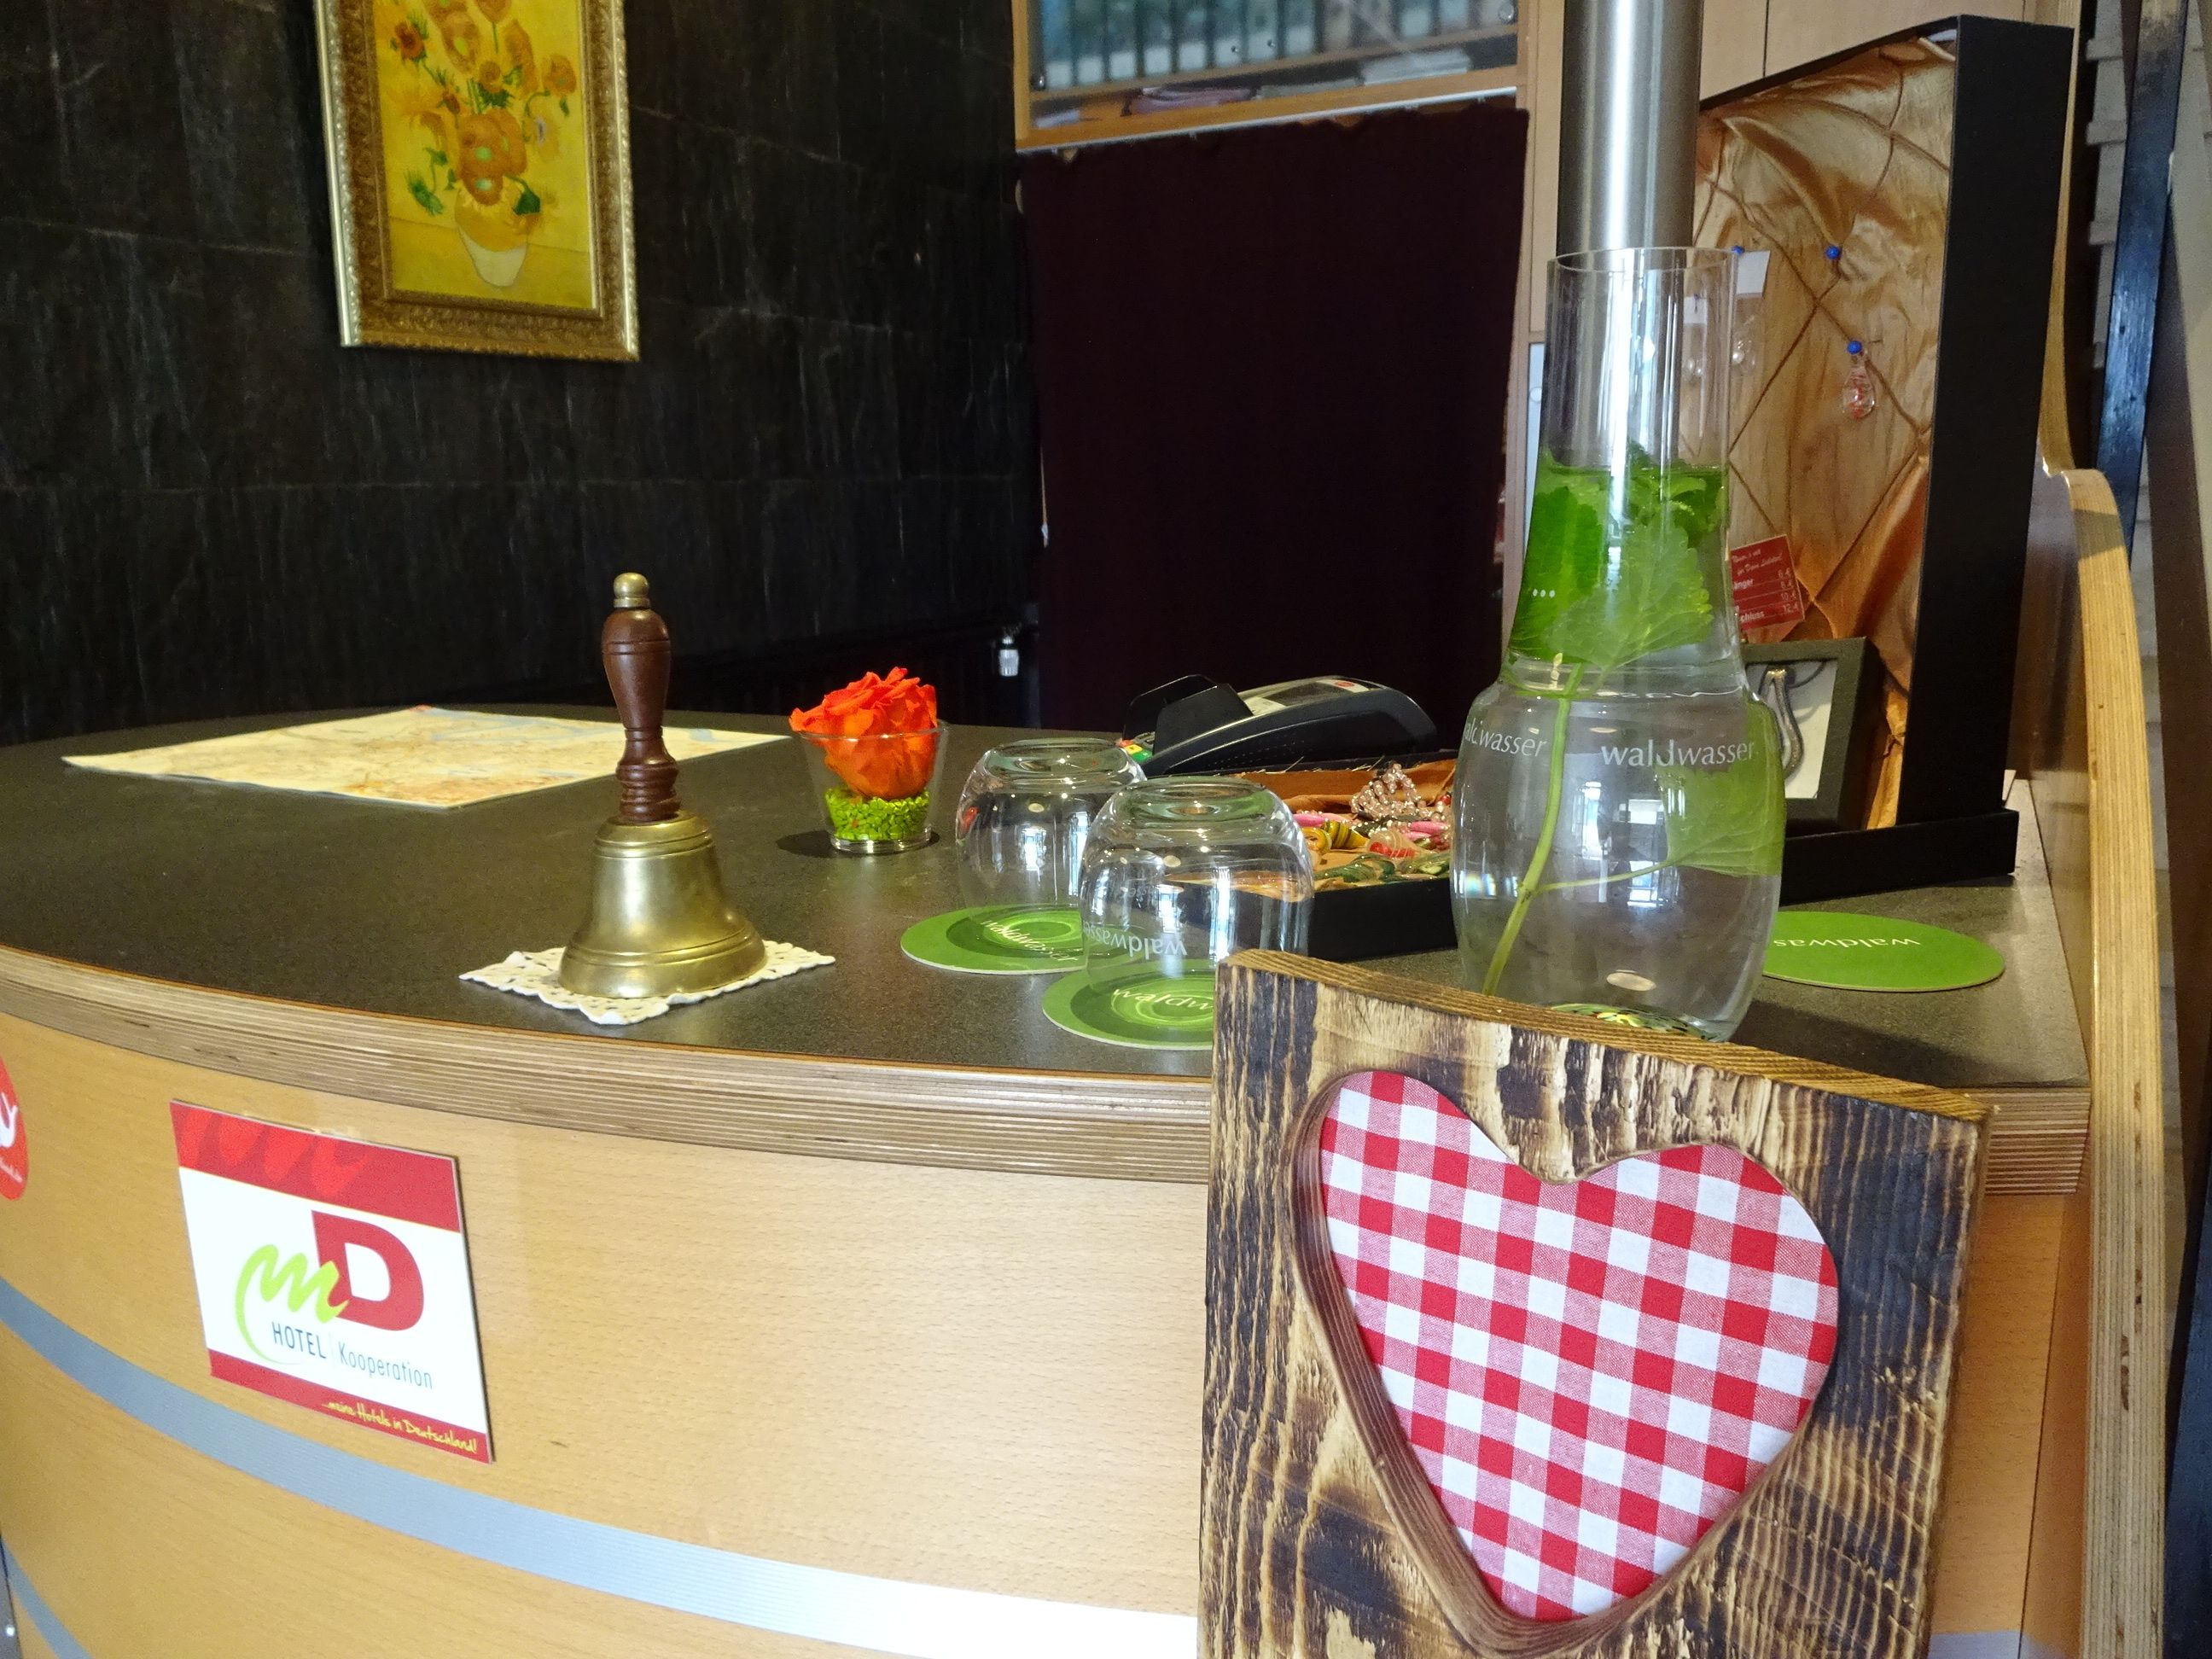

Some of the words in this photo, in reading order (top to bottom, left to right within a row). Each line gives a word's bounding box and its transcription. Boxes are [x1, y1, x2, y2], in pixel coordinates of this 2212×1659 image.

[1601, 738, 1755, 767] waldwasser
[271, 1321, 327, 1359] HOTEL
[338, 1341, 434, 1391] Kooperation
[356, 1401, 391, 1428] Hotels
[393, 1417, 403, 1431] in
